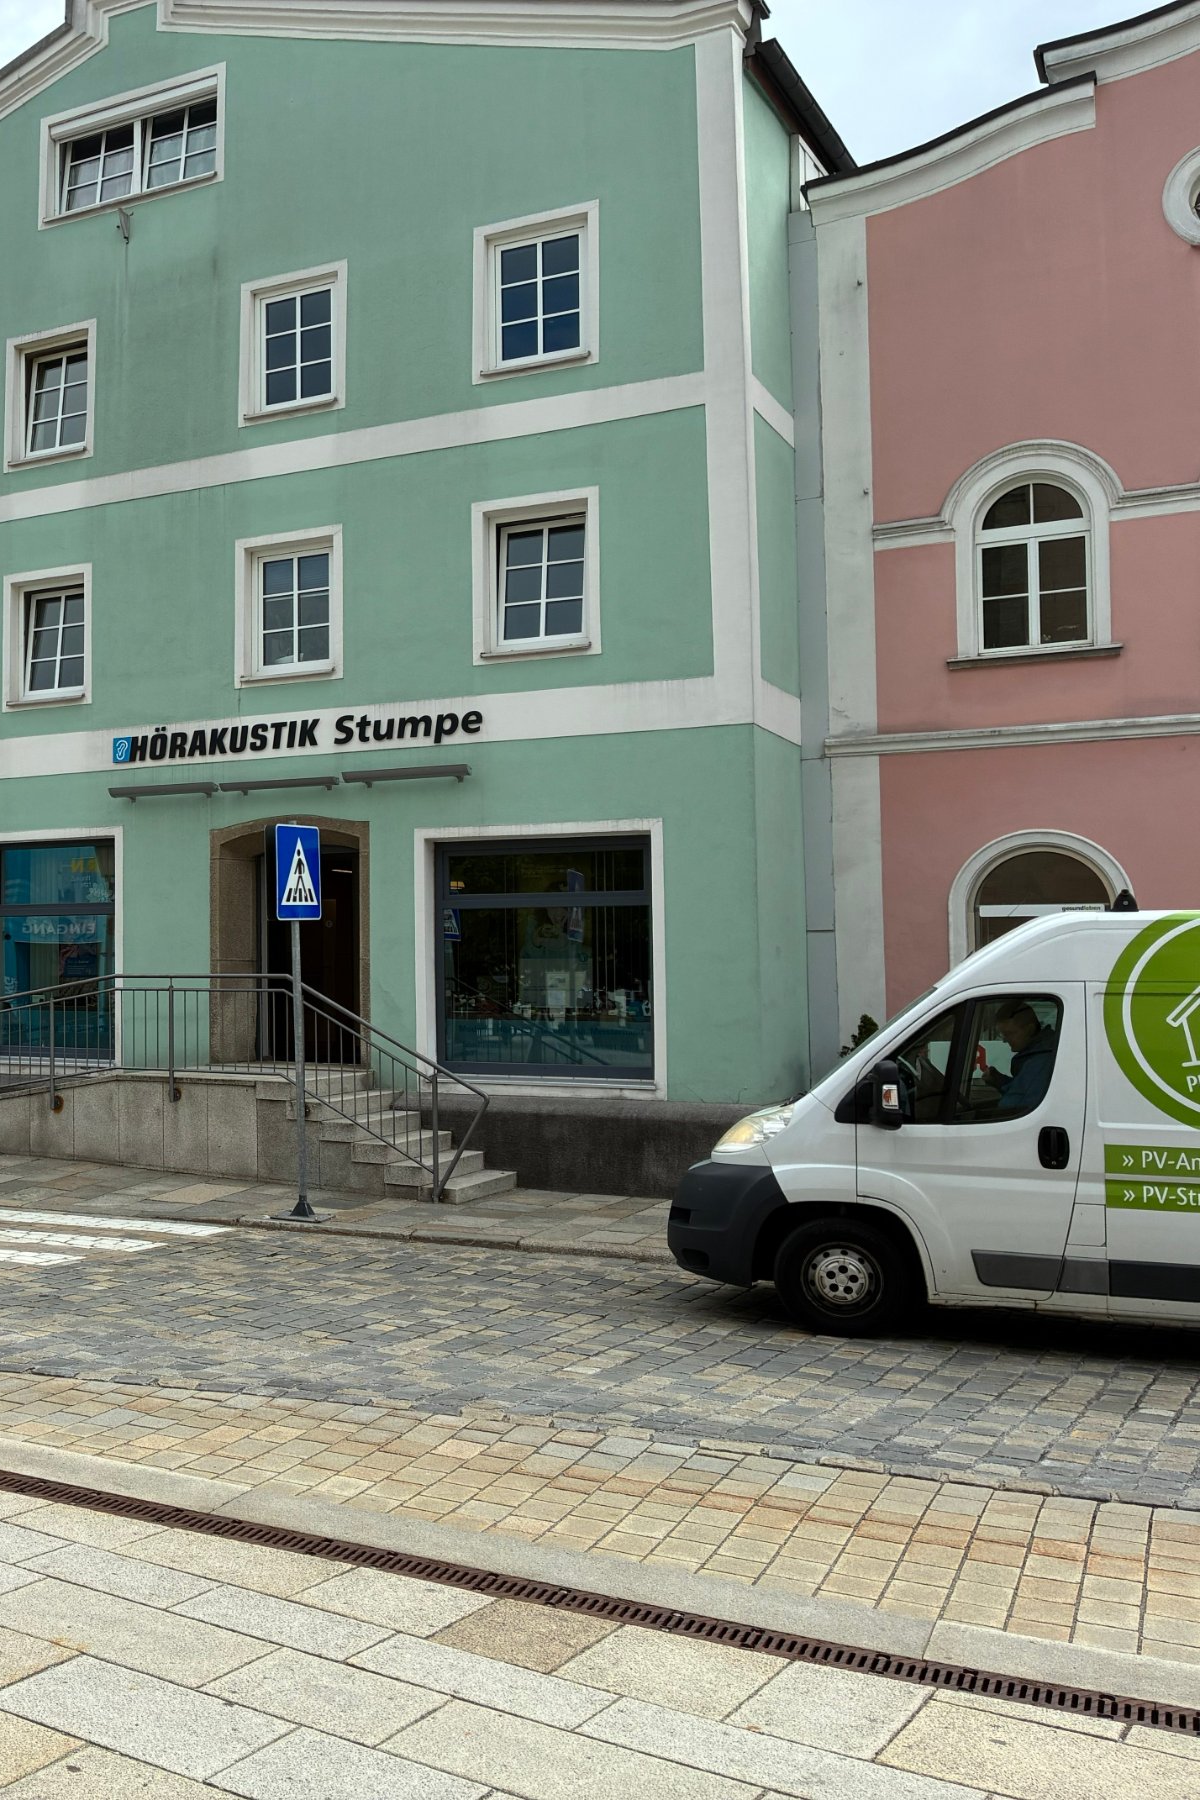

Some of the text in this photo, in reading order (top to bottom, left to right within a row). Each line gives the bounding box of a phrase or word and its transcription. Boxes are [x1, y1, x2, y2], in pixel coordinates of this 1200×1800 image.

[130, 710, 484, 763] HÖRAKUSTIK Stumpe
[1186, 1074, 1200, 1093] P
[1141, 1151, 1200, 1171] PV-An
